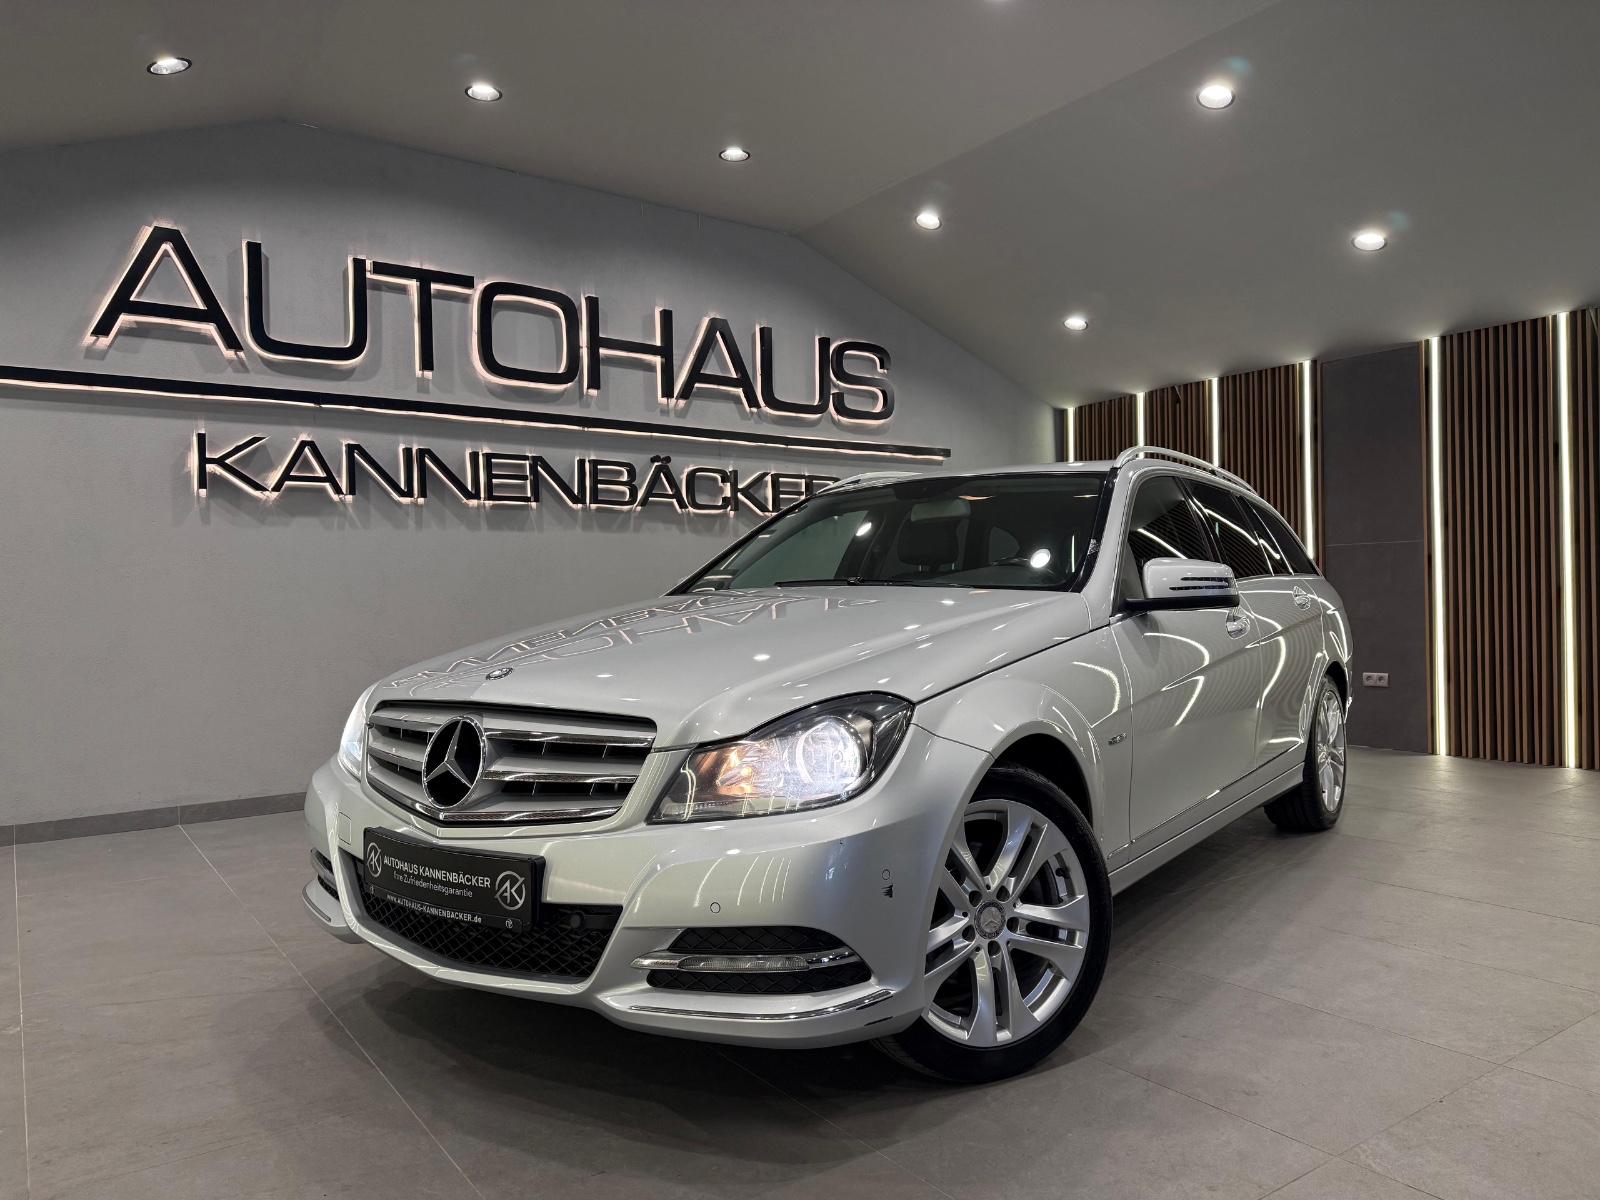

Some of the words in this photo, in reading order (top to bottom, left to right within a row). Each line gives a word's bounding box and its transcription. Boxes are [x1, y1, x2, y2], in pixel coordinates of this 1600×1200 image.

[89, 225, 894, 420] AUTOHAUS
[383, 855, 418, 875] AUTOHAUS
[419, 865, 491, 888] KANNENBÄCKER
[403, 874, 473, 898] Zufriedenheitsgarantie
